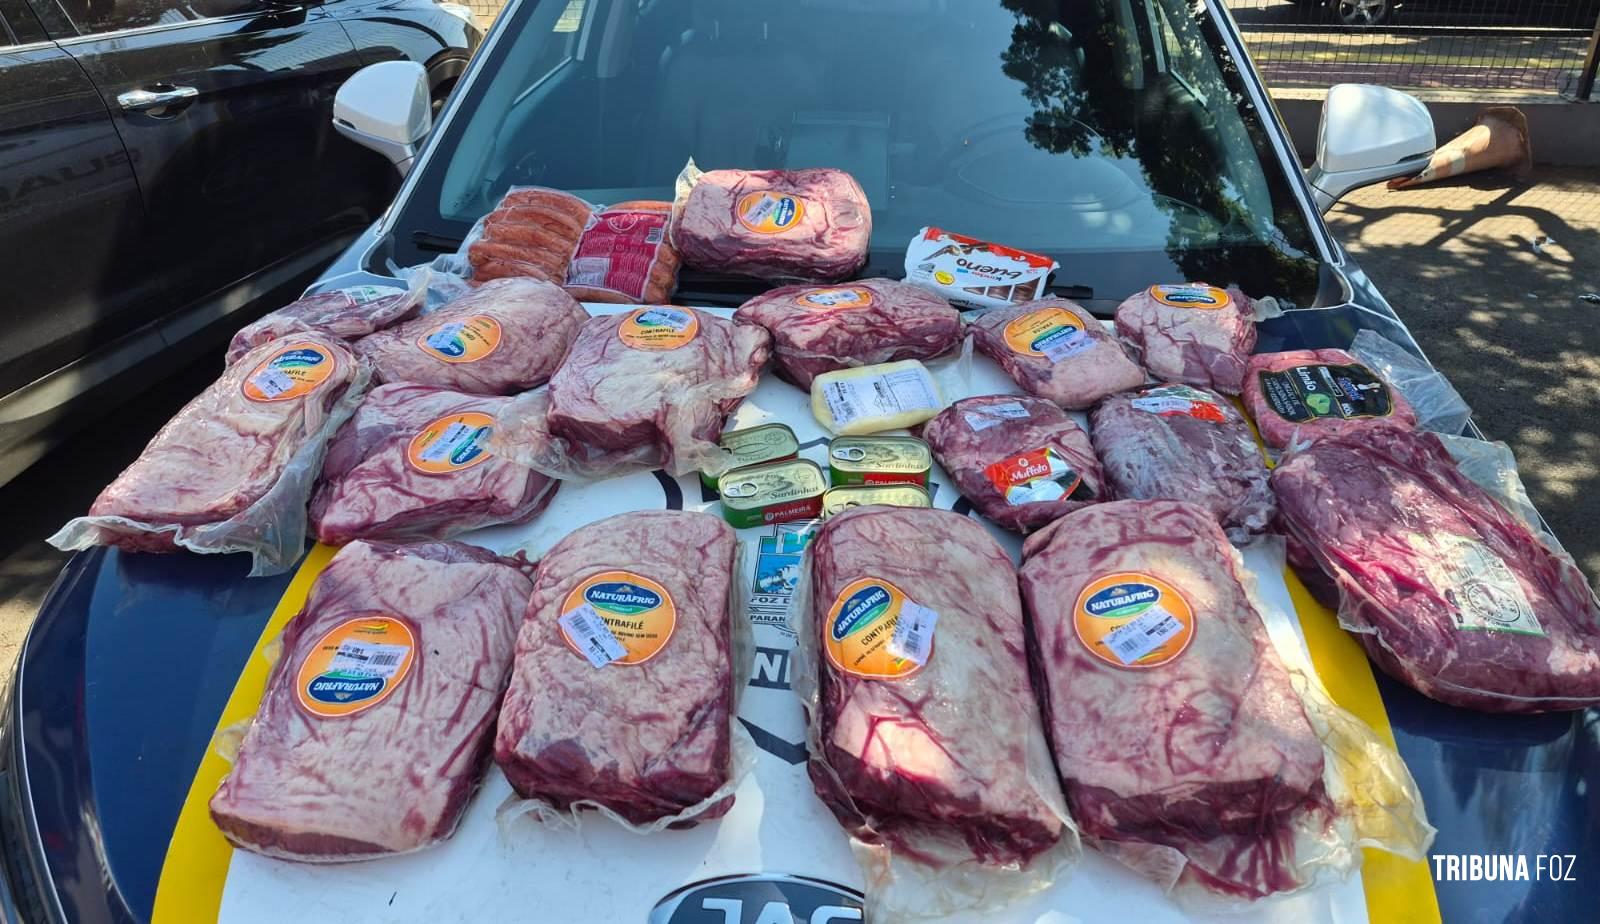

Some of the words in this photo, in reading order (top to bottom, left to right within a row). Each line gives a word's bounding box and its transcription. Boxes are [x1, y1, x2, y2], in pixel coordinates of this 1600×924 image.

[956, 258, 1023, 280] bueno
[1295, 366, 1317, 391] Limão
[1010, 463, 1048, 482] Muffato
[770, 485, 820, 500] Sardinhas
[774, 505, 812, 519] PALMEIRA
[590, 590, 656, 605] NATURAFRIG
[1090, 589, 1155, 611] NATURAFRIG
[838, 591, 886, 634] NATURAFRIG
[313, 681, 379, 692] NATURAFRIG
